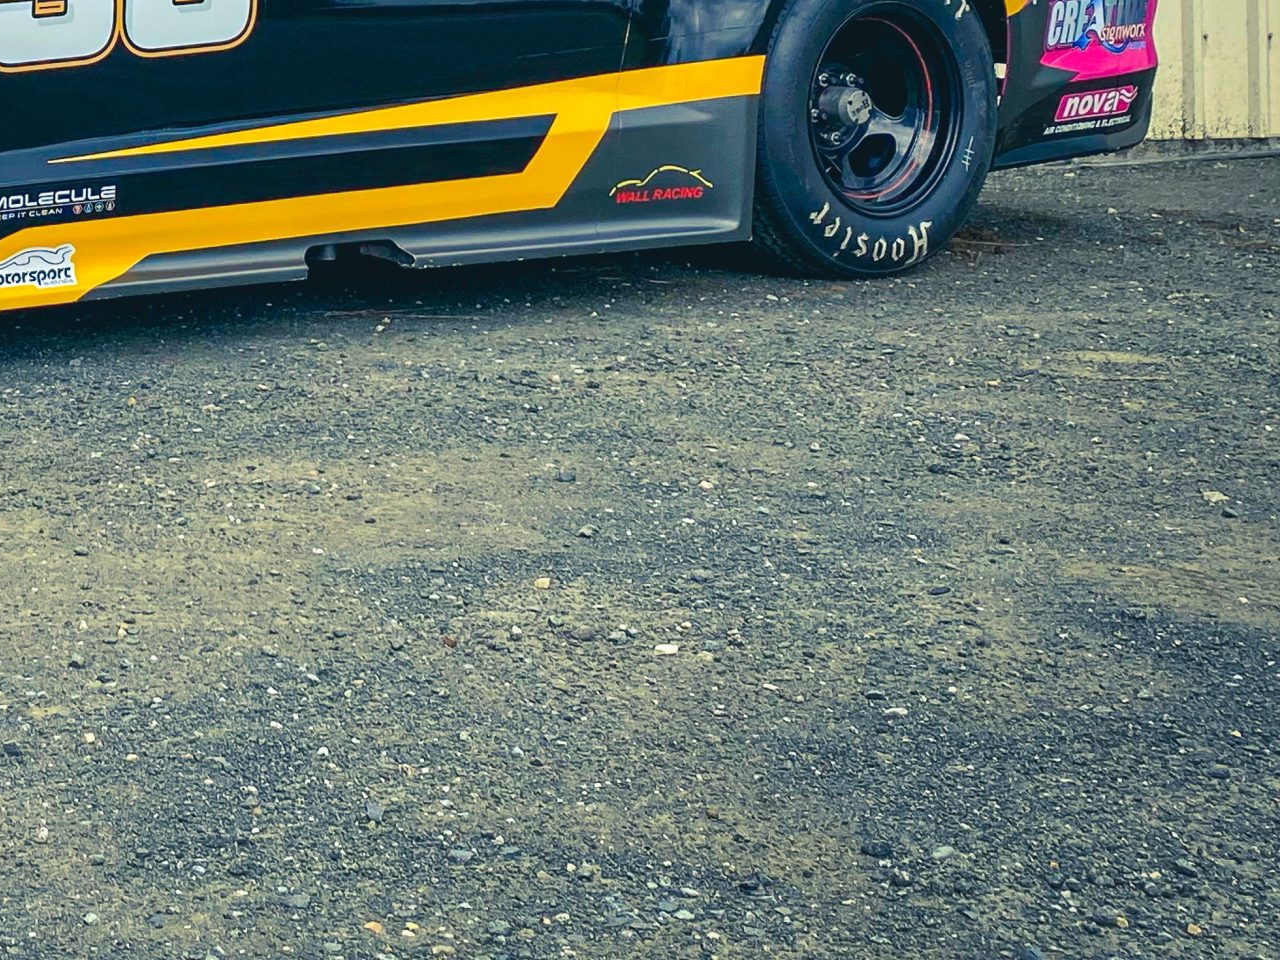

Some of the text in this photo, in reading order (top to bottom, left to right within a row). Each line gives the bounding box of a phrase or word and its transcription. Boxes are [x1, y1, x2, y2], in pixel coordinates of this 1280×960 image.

[1062, 91, 1120, 118] nova
[615, 186, 704, 204] WALL RACING
[28, 208, 63, 218] CLEAN
[809, 202, 932, 265] Hoosier
